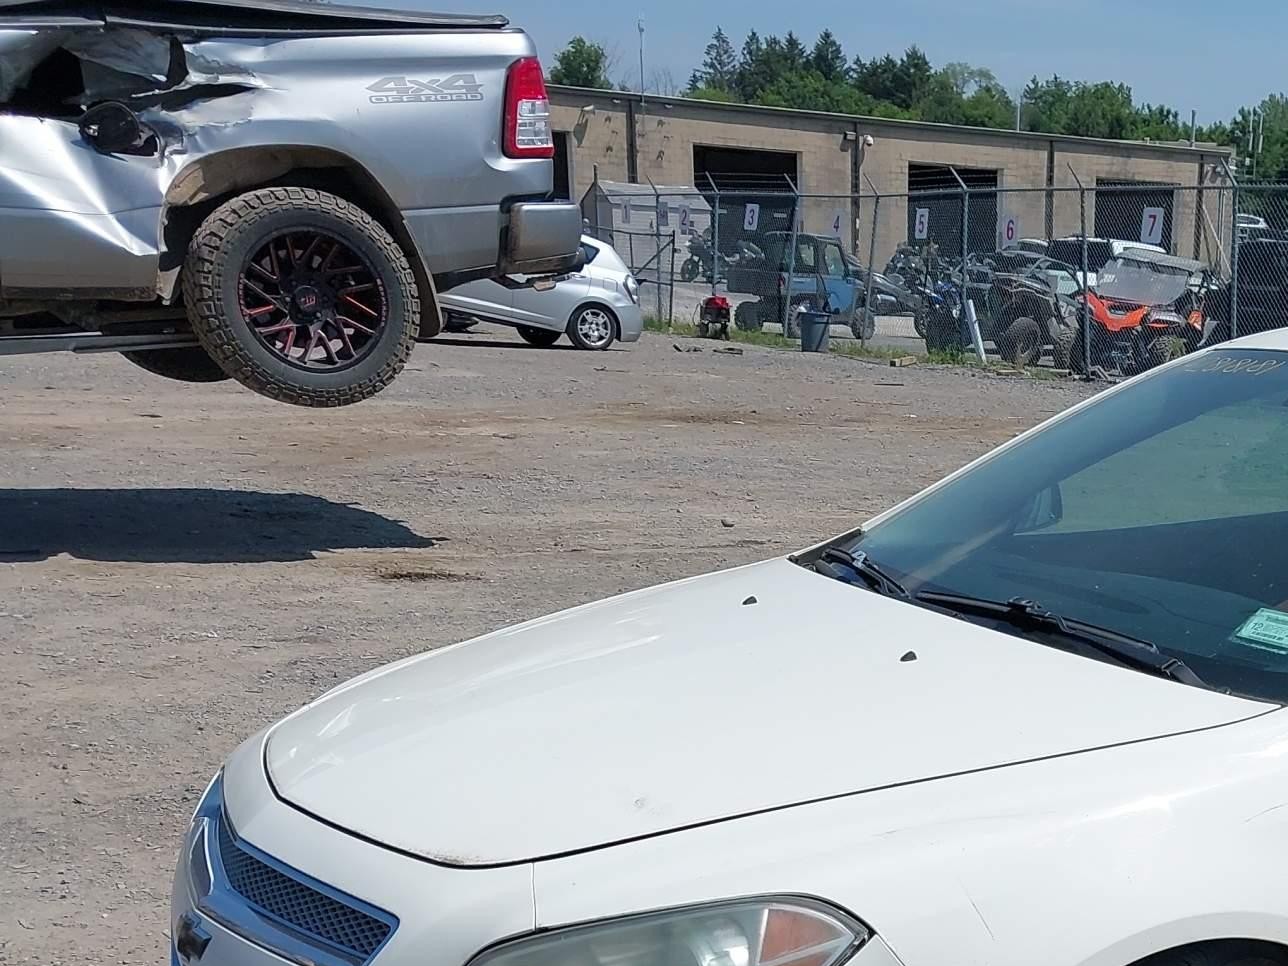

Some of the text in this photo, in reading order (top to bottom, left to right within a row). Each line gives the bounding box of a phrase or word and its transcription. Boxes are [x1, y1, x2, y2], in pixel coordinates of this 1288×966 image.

[420, 93, 484, 102] ROAD
[680, 208, 688, 226] 2
[747, 208, 755, 226] 3
[833, 215, 840, 233] 4
[918, 213, 925, 233] 5
[1147, 213, 1157, 237] 7
[1006, 218, 1014, 241] 6
